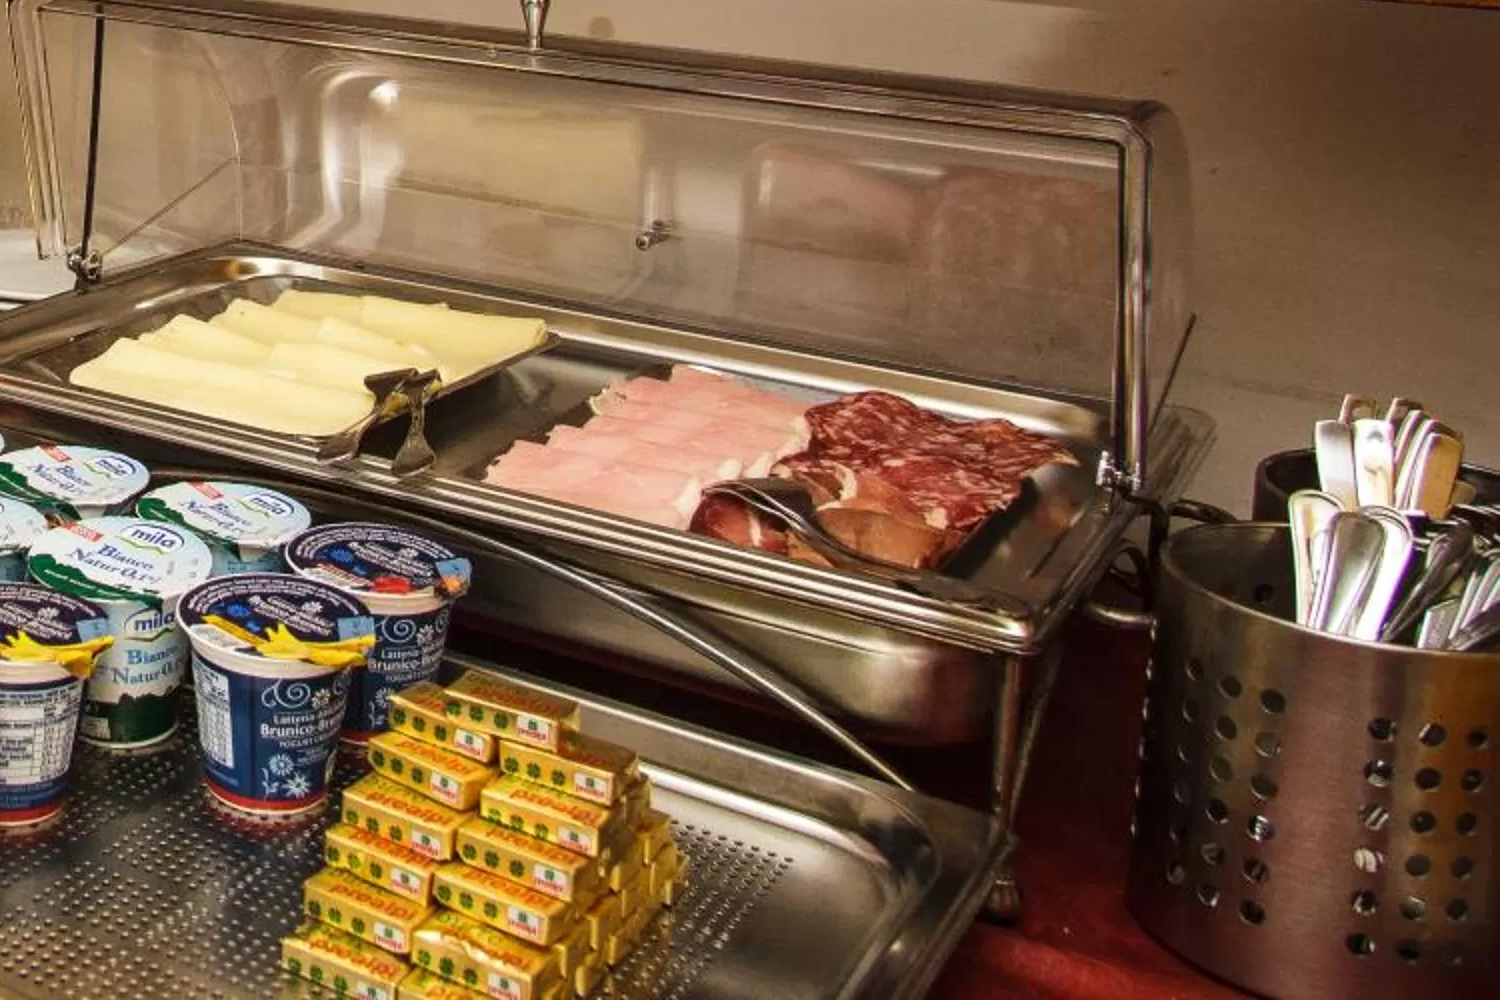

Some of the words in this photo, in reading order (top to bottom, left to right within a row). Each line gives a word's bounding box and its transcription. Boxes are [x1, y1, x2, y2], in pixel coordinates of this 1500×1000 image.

[131, 528, 177, 549] mila
[97, 543, 154, 570] Bianco
[135, 612, 176, 633] mila
